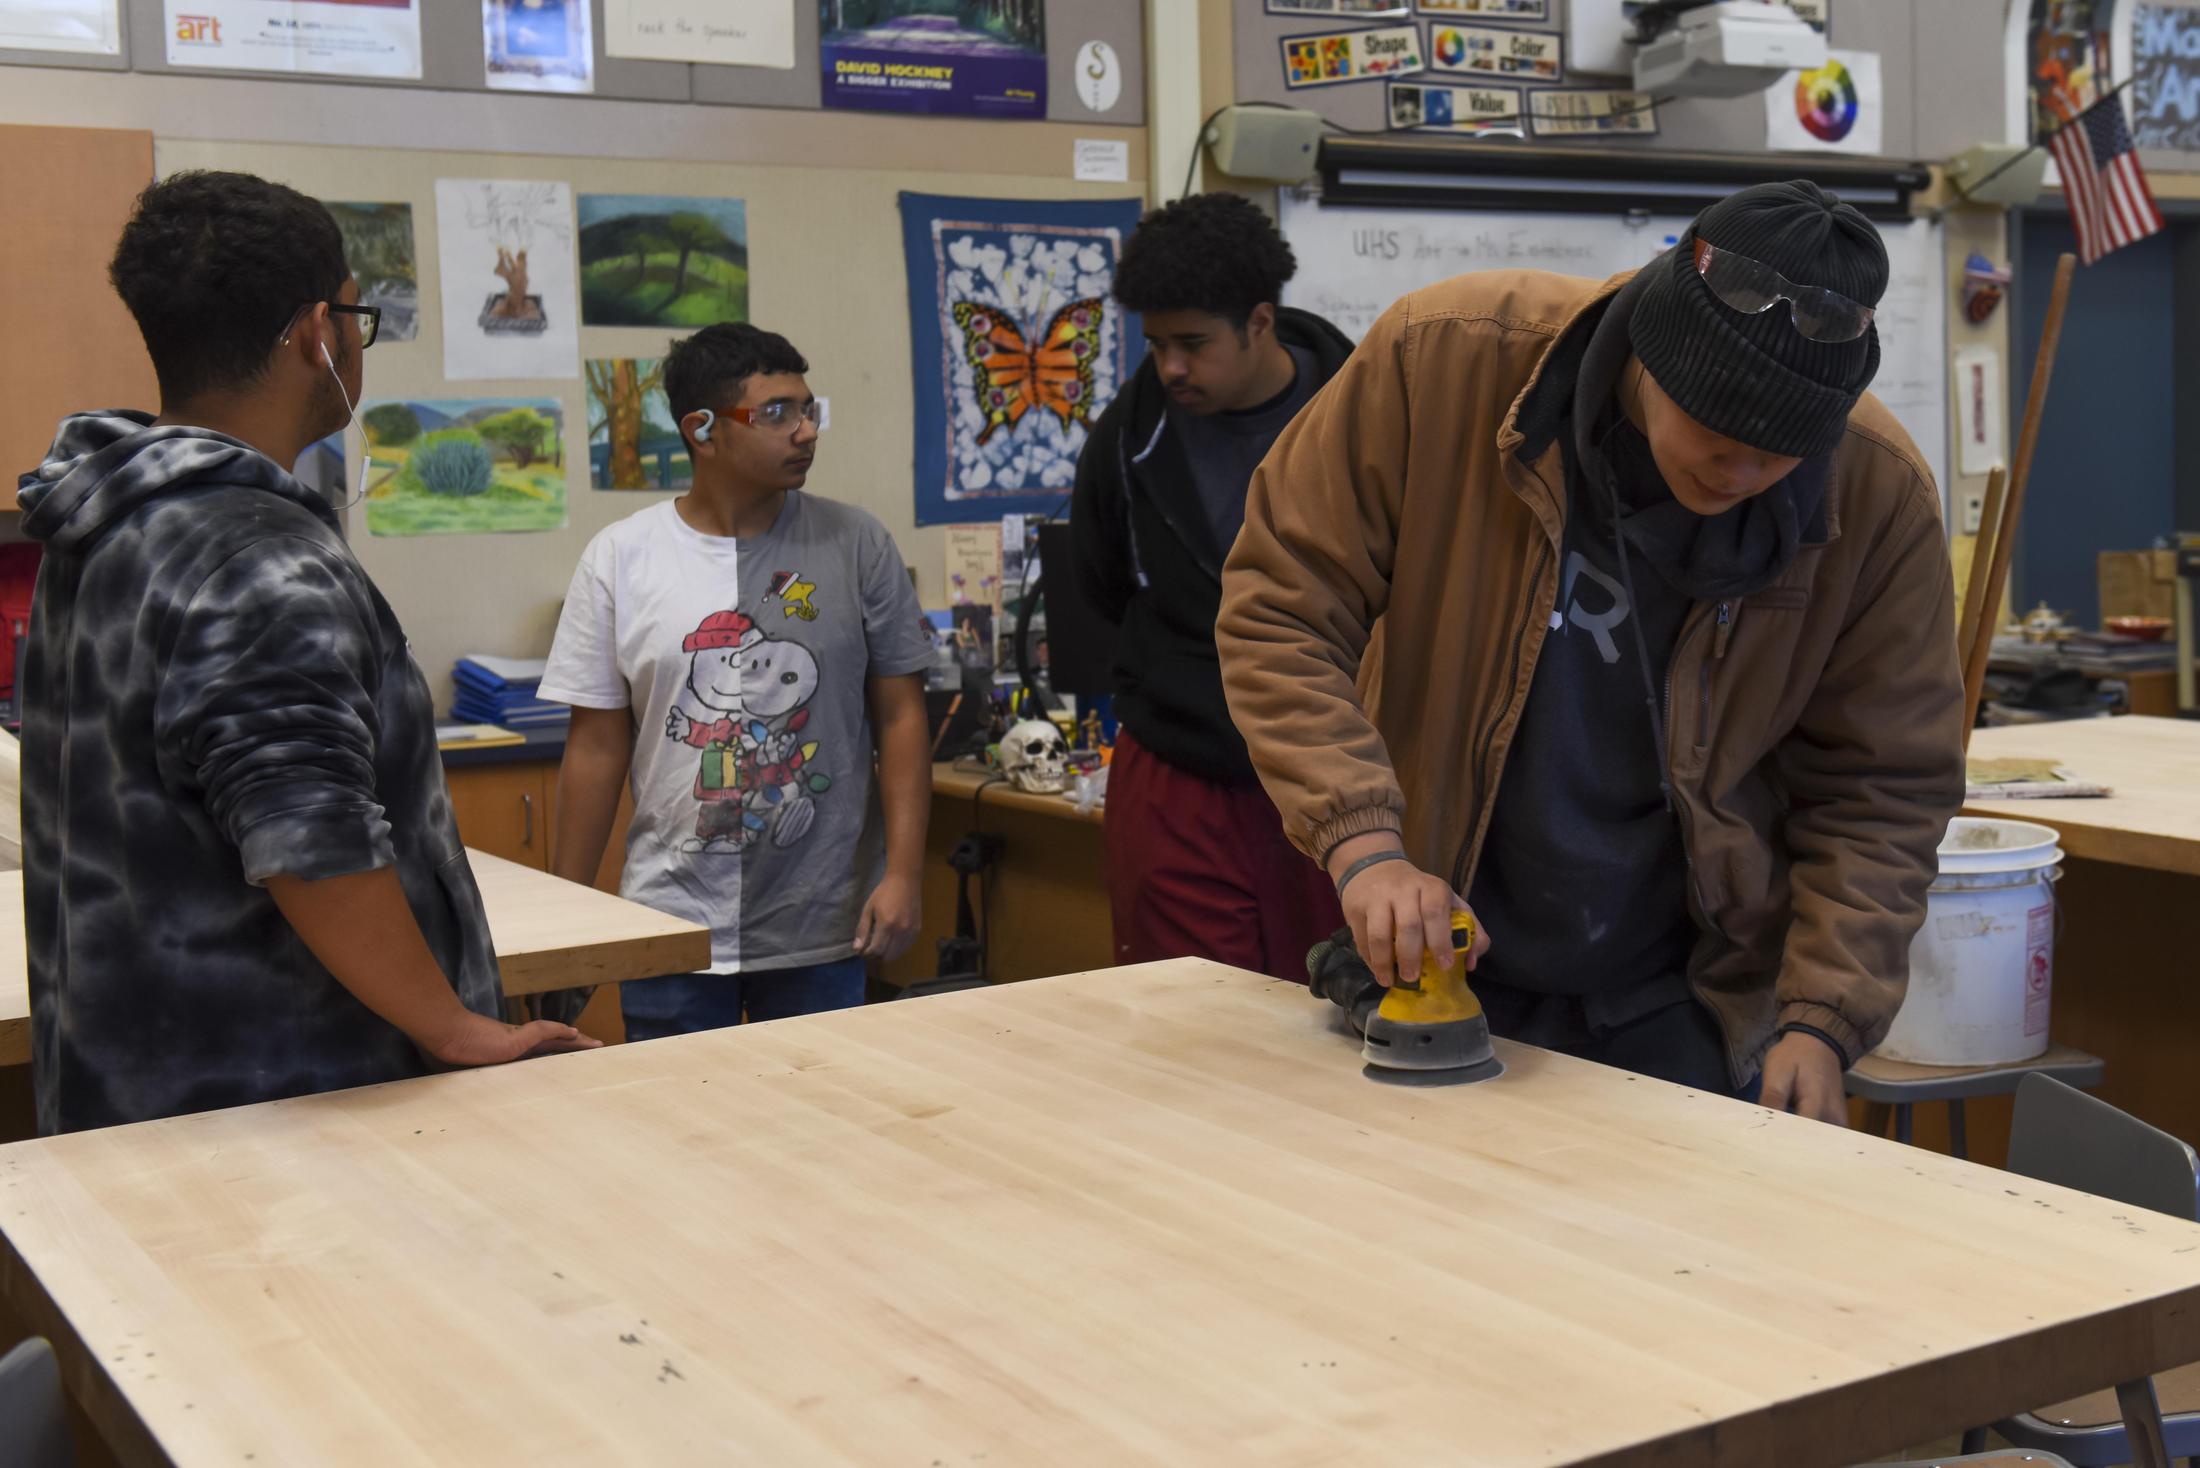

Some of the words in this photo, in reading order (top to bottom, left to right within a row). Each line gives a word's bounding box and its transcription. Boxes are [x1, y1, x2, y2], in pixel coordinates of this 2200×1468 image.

[1364, 34, 1408, 56] Shape
[1510, 36, 1546, 57] Color
[836, 60, 881, 75] DAVID
[884, 64, 953, 79] HOCKNEY
[836, 75, 845, 85] A
[848, 75, 887, 87] BIGGER
[890, 78, 952, 90] EXHIBITION
[1469, 91, 1506, 113] Value
[1353, 229, 1400, 260] UHS
